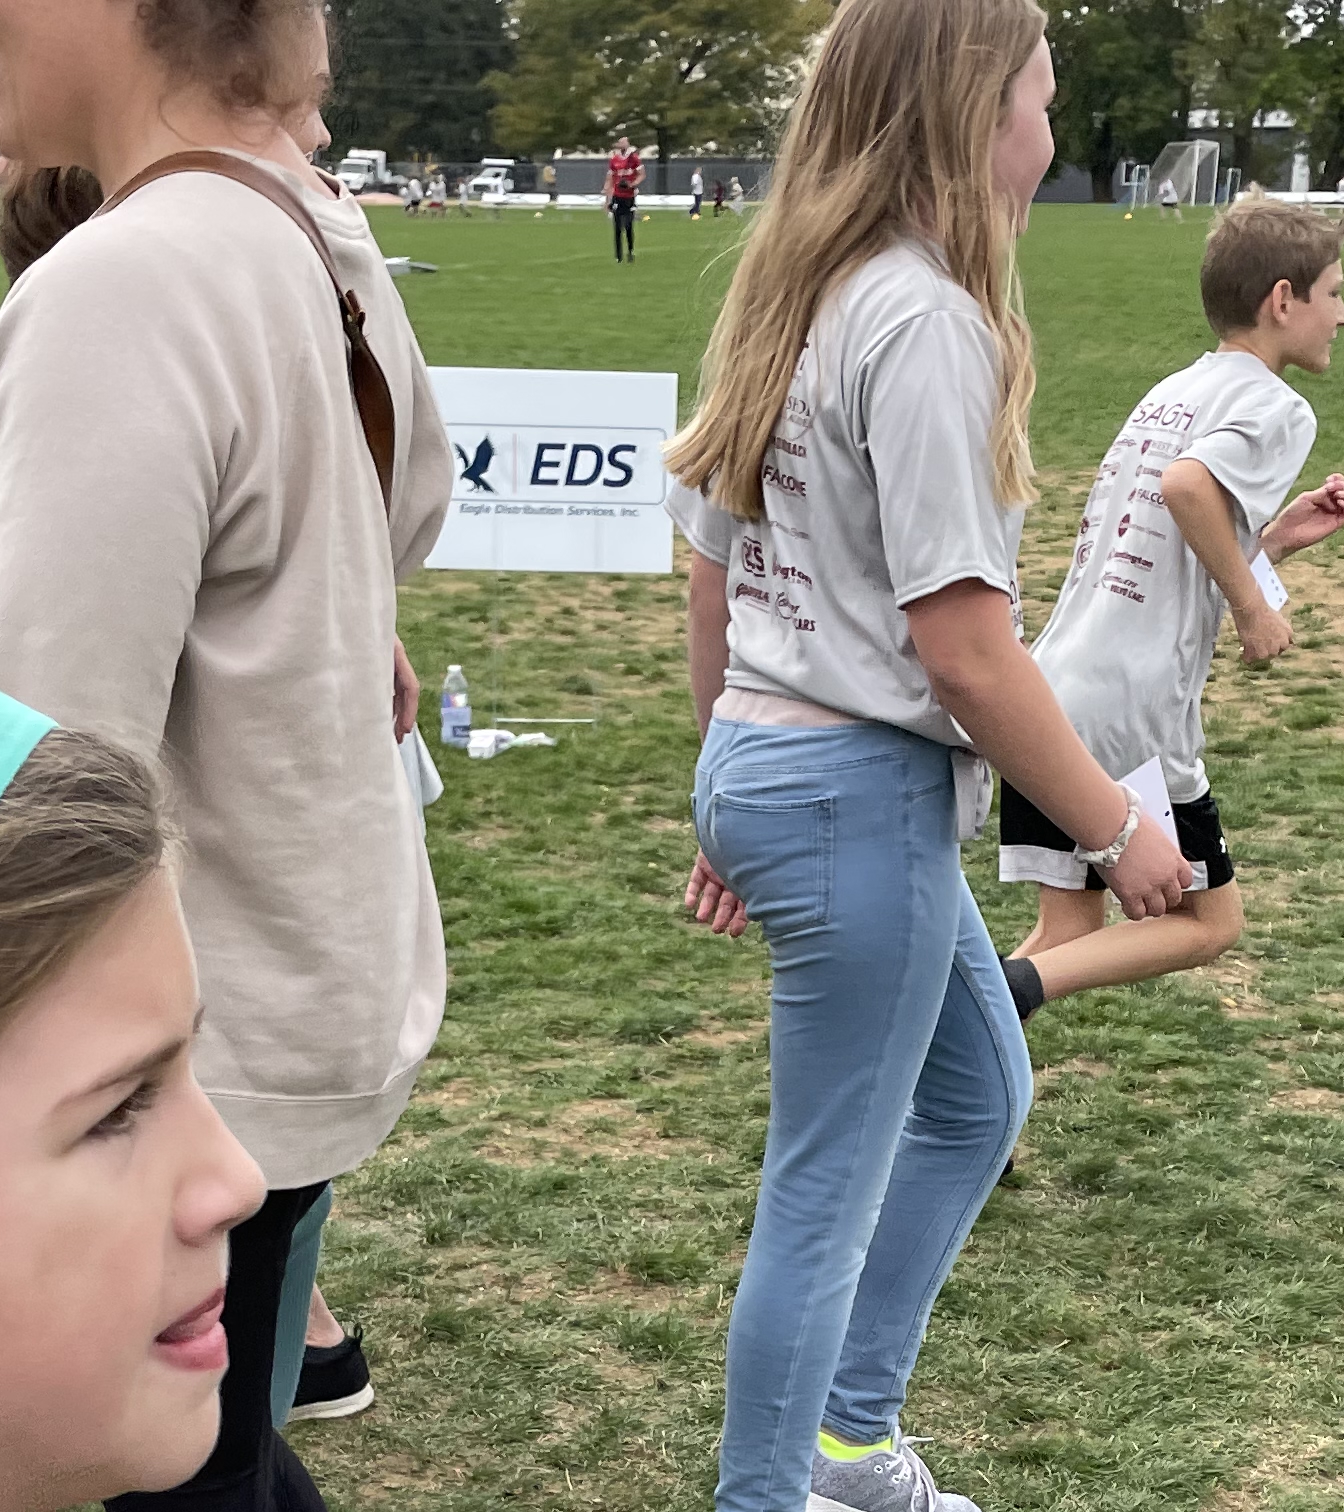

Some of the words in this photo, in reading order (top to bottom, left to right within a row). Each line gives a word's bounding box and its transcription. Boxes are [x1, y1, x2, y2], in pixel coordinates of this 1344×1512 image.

[1132, 402, 1200, 432] SAGH
[529, 442, 638, 488] EDS
[460, 503, 492, 515] Eagle
[495, 503, 564, 515] Distribution
[1137, 488, 1165, 506] FALCO
